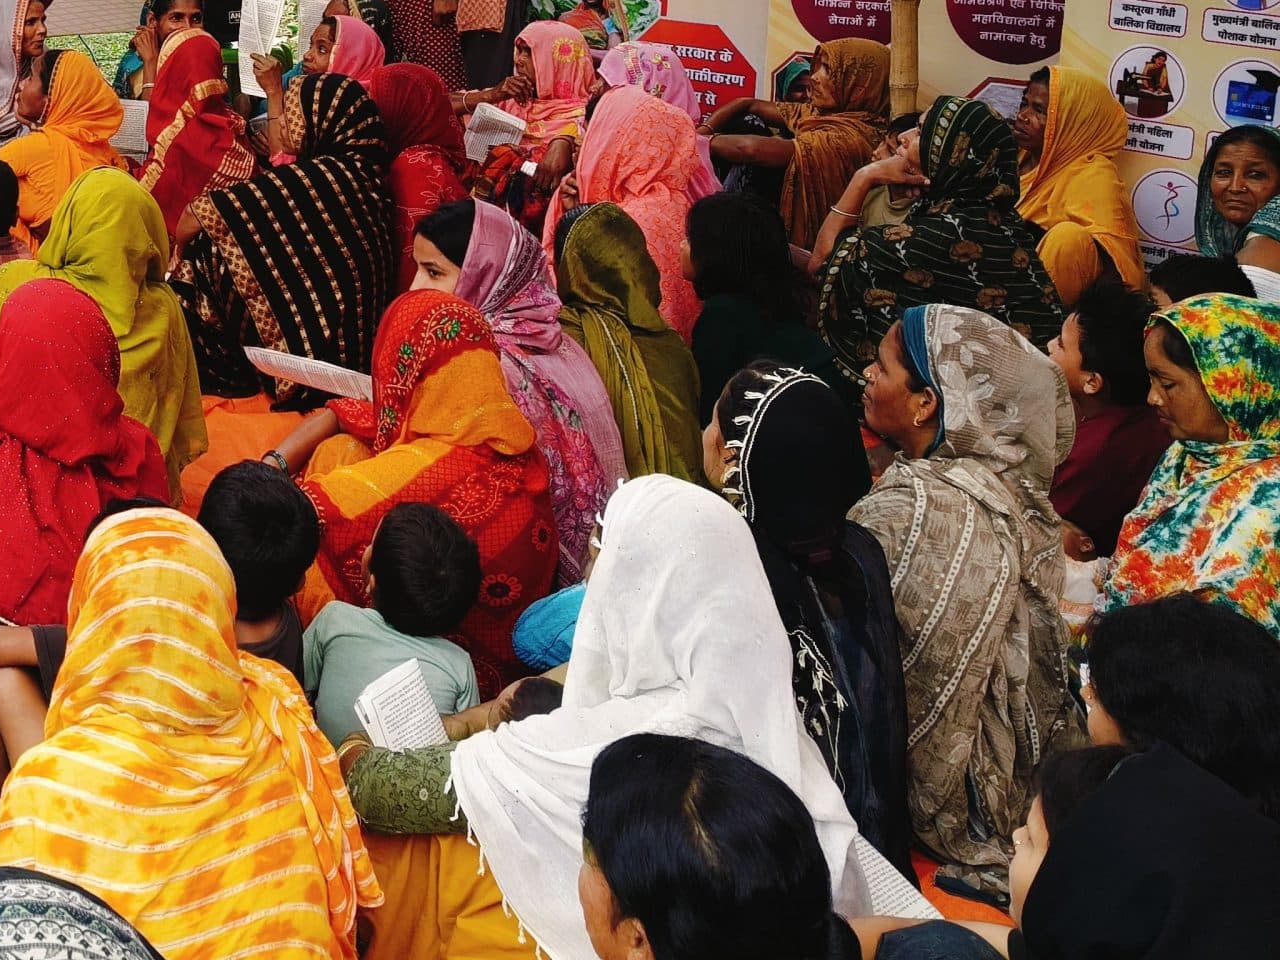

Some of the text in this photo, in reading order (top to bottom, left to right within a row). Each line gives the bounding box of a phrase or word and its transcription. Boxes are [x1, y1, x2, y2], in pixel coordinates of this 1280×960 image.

[828, 13, 876, 28] सेवाओं में
[1046, 15, 1056, 29] में
[1114, 17, 1181, 34] बालिका विद्यालय
[1212, 14, 1249, 29] मुख्यमंत्री
[979, 29, 1047, 49] नामांकन हेतु
[1218, 29, 1276, 46] पोशाक योजना
[676, 45, 734, 63] सरकार के
[1147, 126, 1173, 138] महिला
[1138, 141, 1164, 152] योजना
